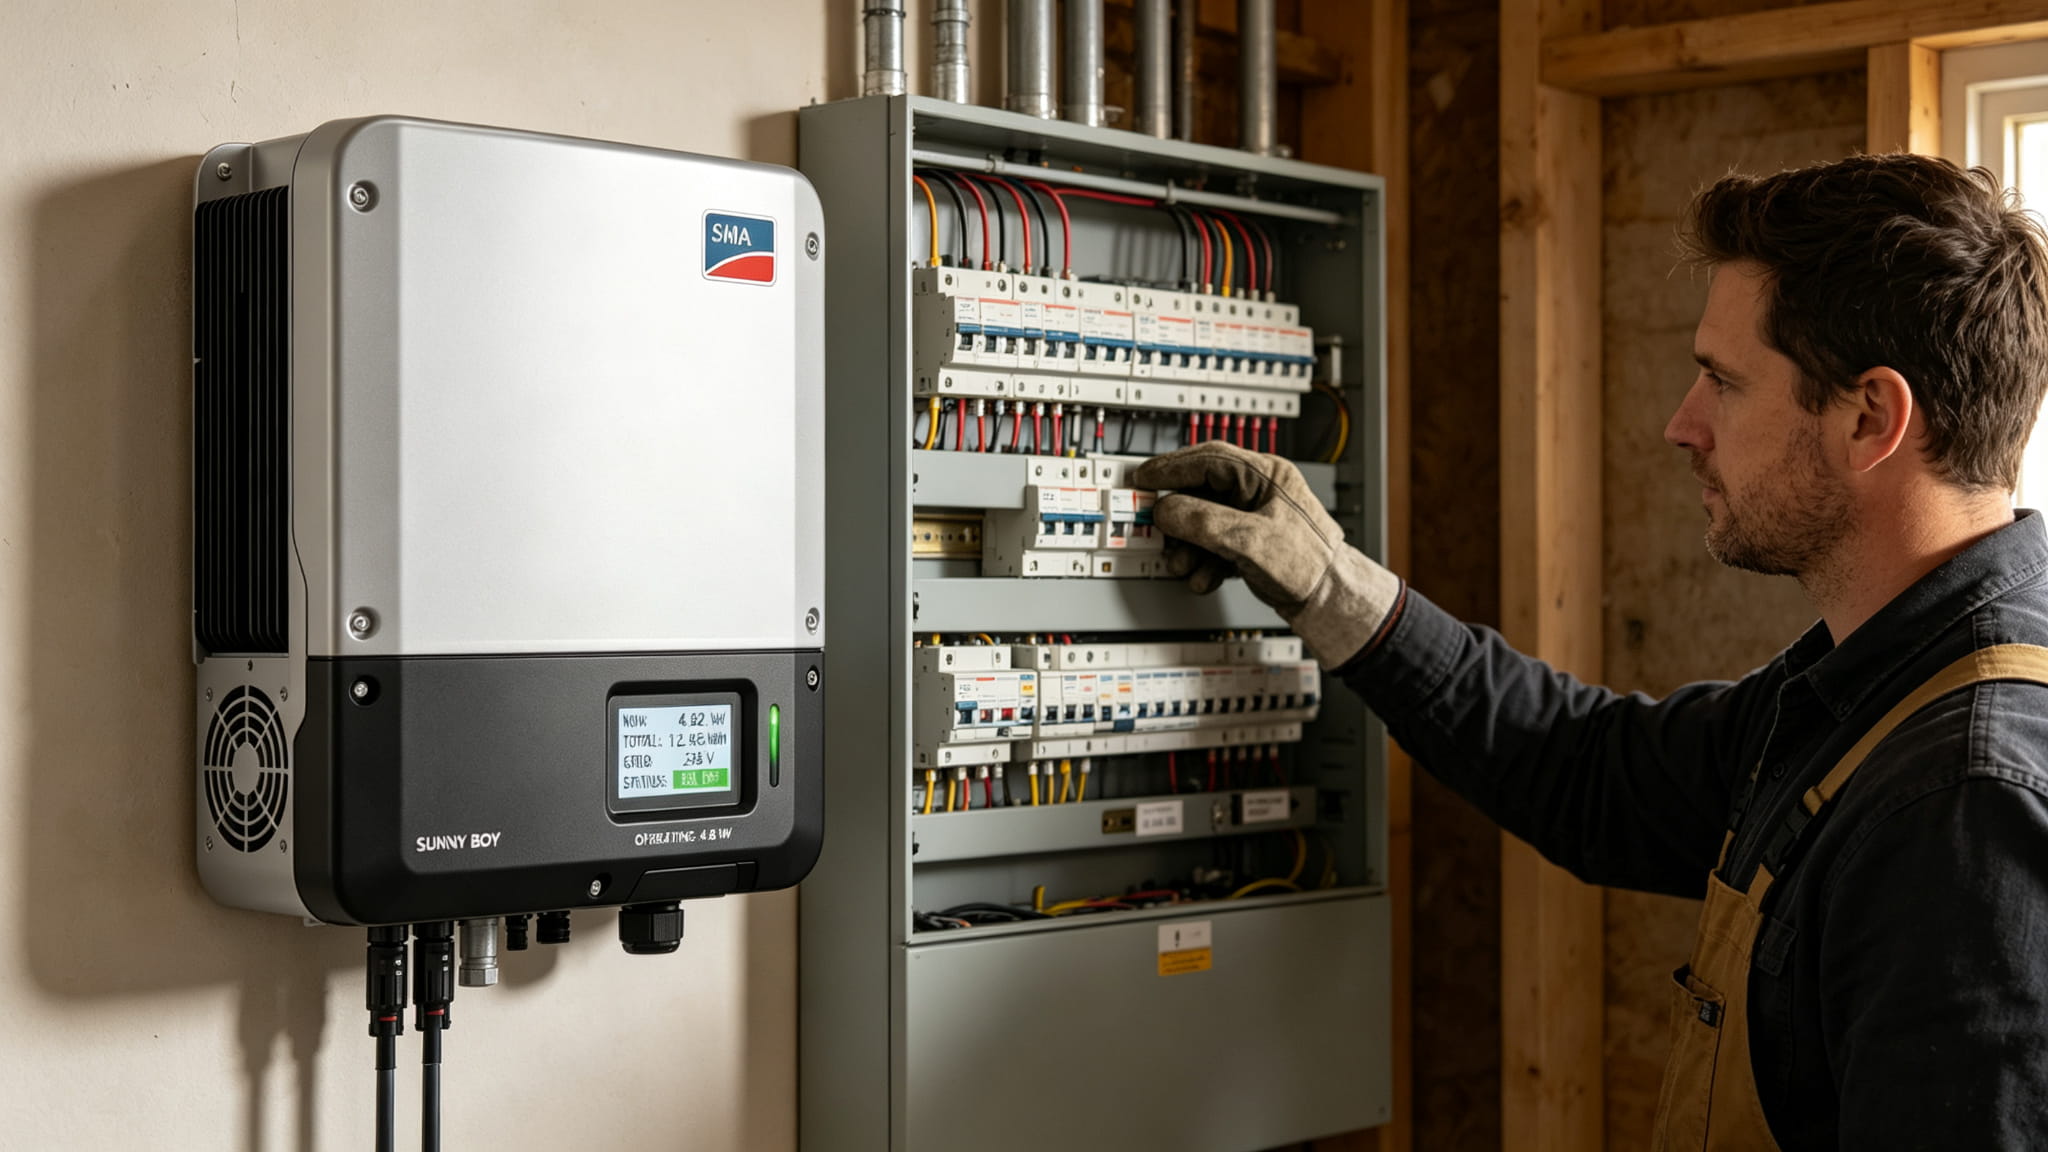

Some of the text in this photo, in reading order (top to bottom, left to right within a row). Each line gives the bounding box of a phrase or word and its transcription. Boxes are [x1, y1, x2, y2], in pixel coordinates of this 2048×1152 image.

[711, 222, 752, 247] SMA
[416, 831, 502, 853] SUNNY BOY
